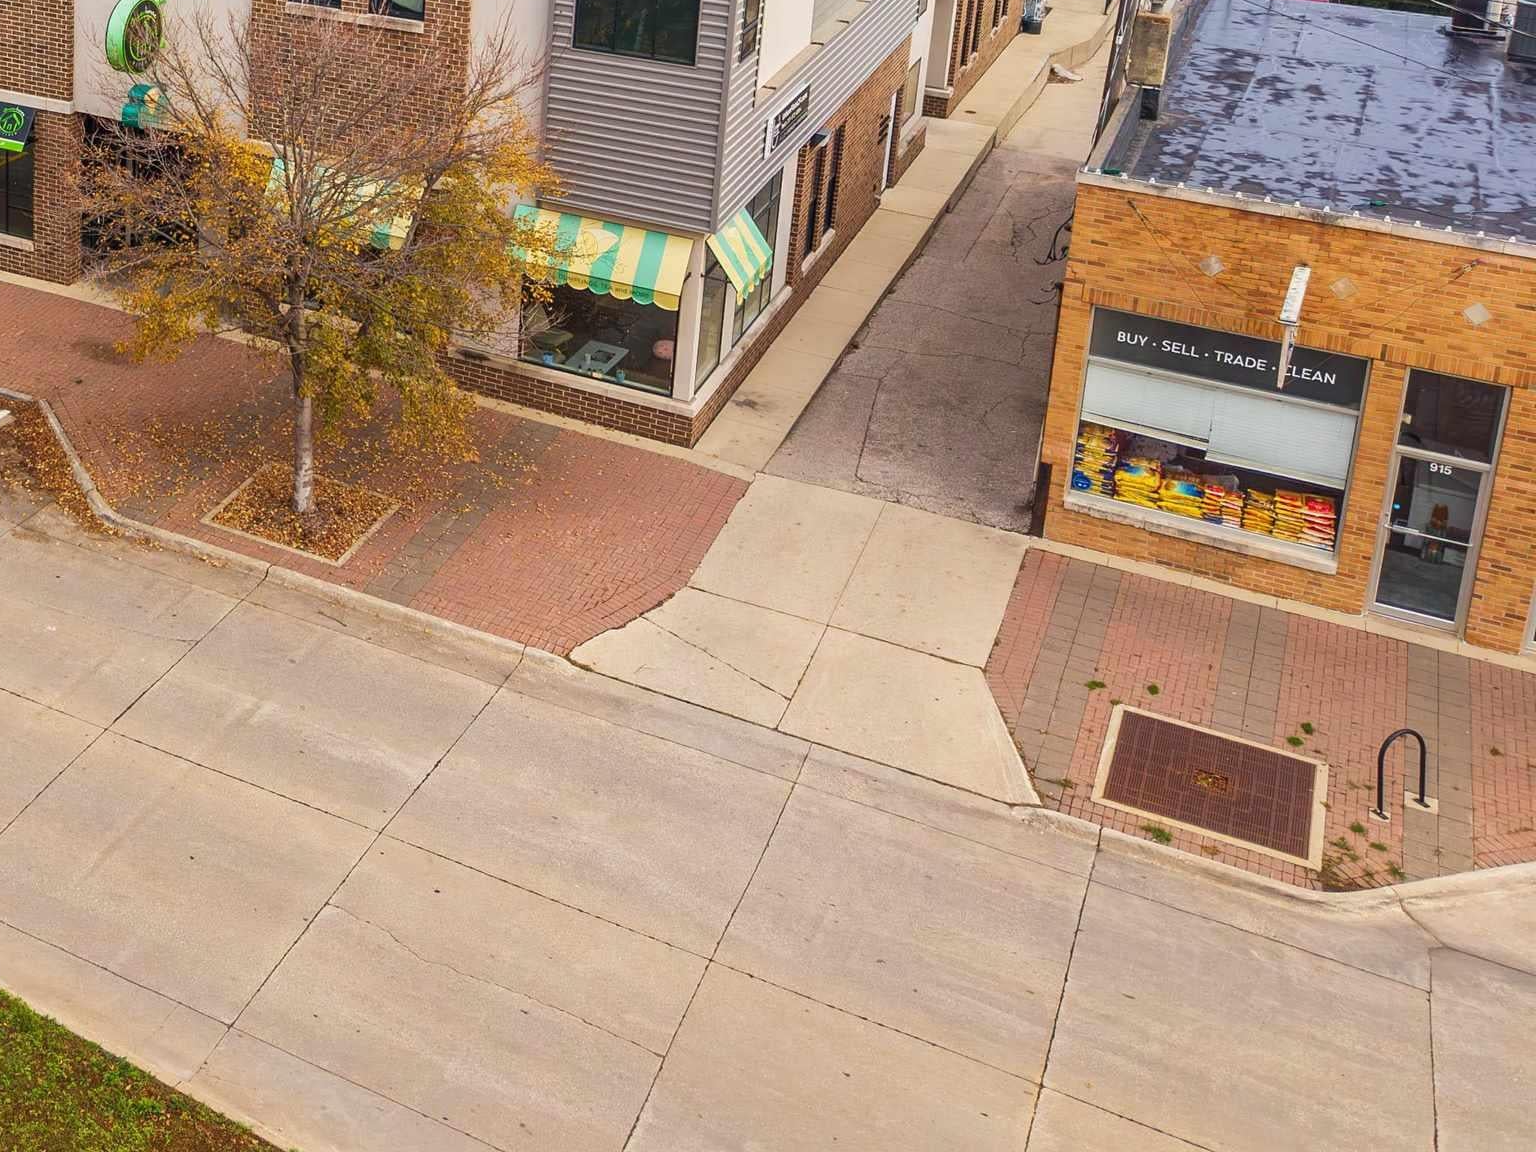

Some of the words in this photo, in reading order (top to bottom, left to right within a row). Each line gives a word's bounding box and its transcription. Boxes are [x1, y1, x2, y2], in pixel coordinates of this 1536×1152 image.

[1117, 331, 1148, 347] BUY
[1161, 340, 1199, 358] SELL
[1214, 350, 1268, 371] TRADE
[1430, 463, 1452, 475] 915
